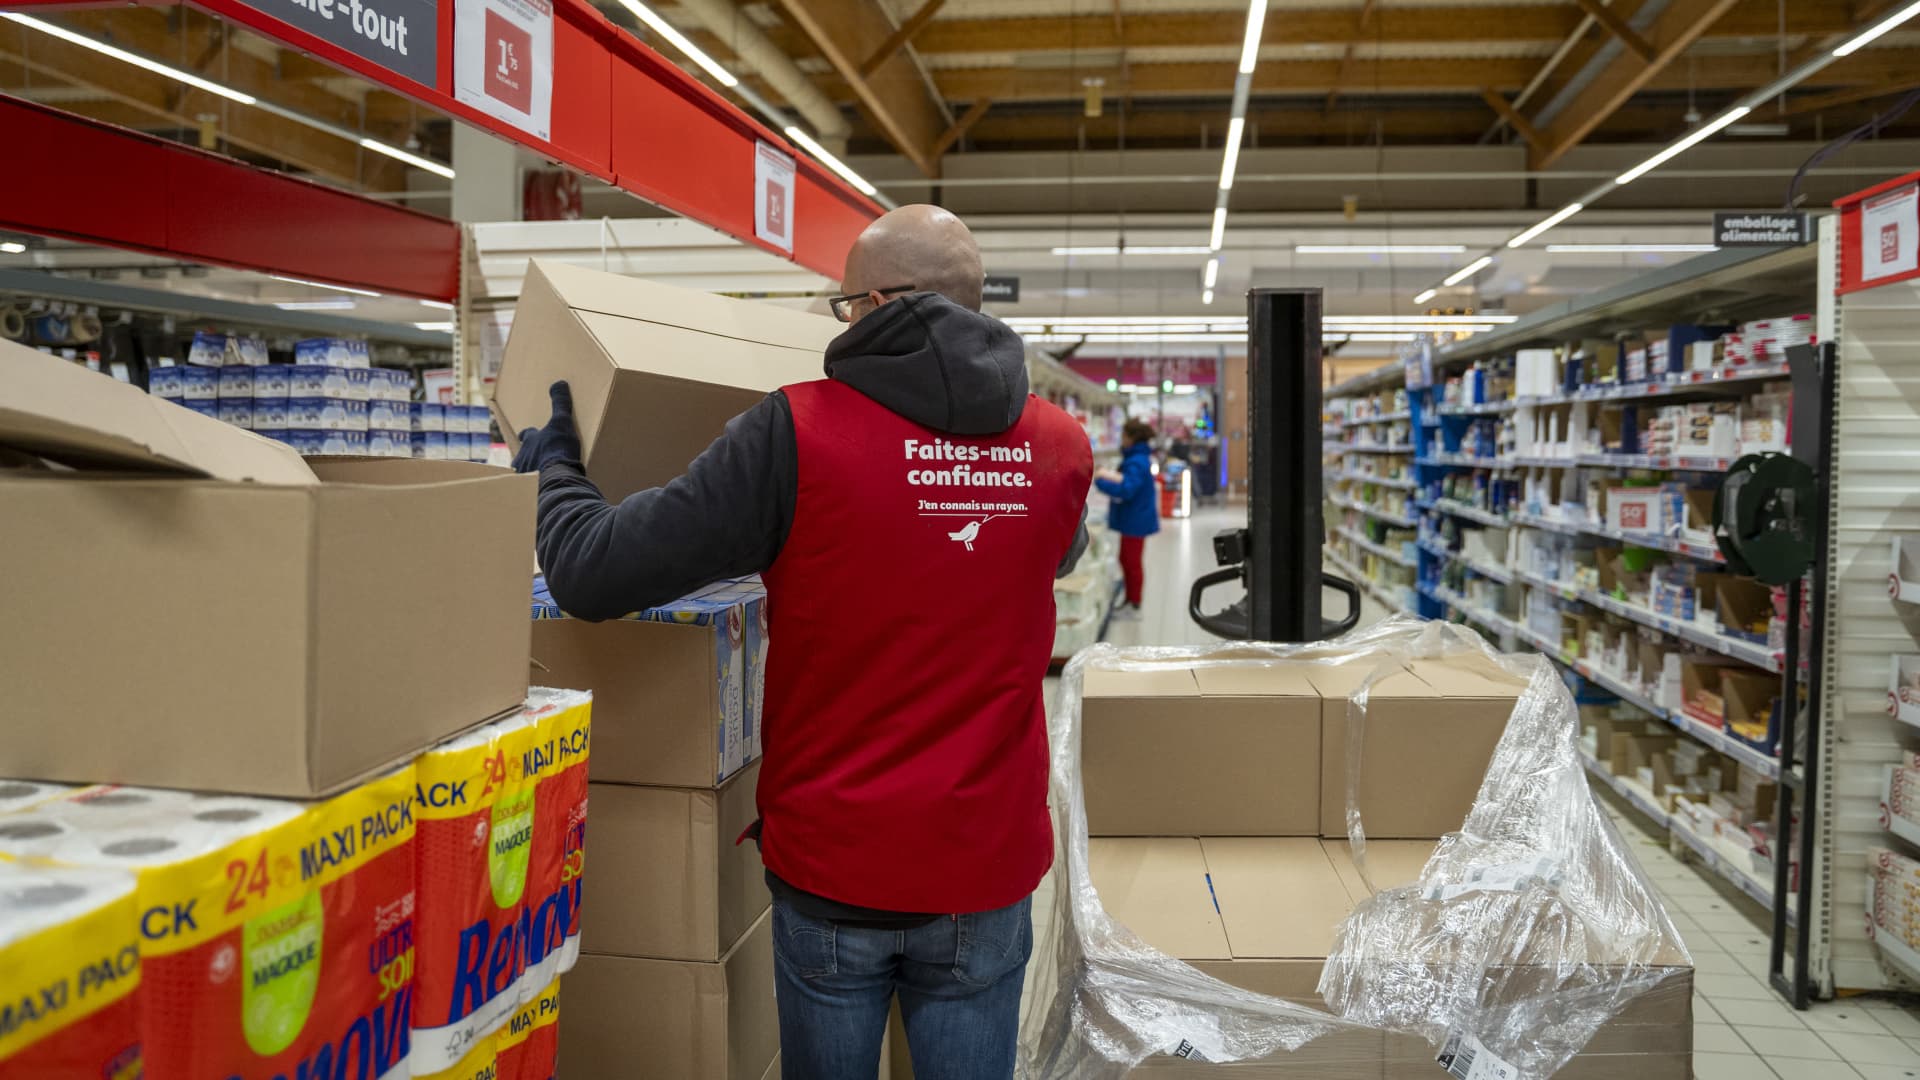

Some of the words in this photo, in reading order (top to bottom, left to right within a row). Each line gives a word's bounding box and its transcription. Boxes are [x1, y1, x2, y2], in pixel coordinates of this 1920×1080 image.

[291, 0, 408, 56] e-tout
[1723, 215, 1797, 232] emballage
[1720, 229, 1800, 242] alimentaire
[904, 438, 1033, 463] Faites-moi
[907, 464, 1033, 487] confiance.
[918, 500, 938, 511] J'en
[940, 500, 981, 511] connais
[982, 502, 995, 511] un
[996, 502, 1029, 513] rayon.
[140, 898, 198, 941] CK
[223, 846, 272, 915] 24
[300, 824, 356, 882] MAXI
[360, 795, 414, 851] PACK
[1177, 1041, 1193, 1057] 010
